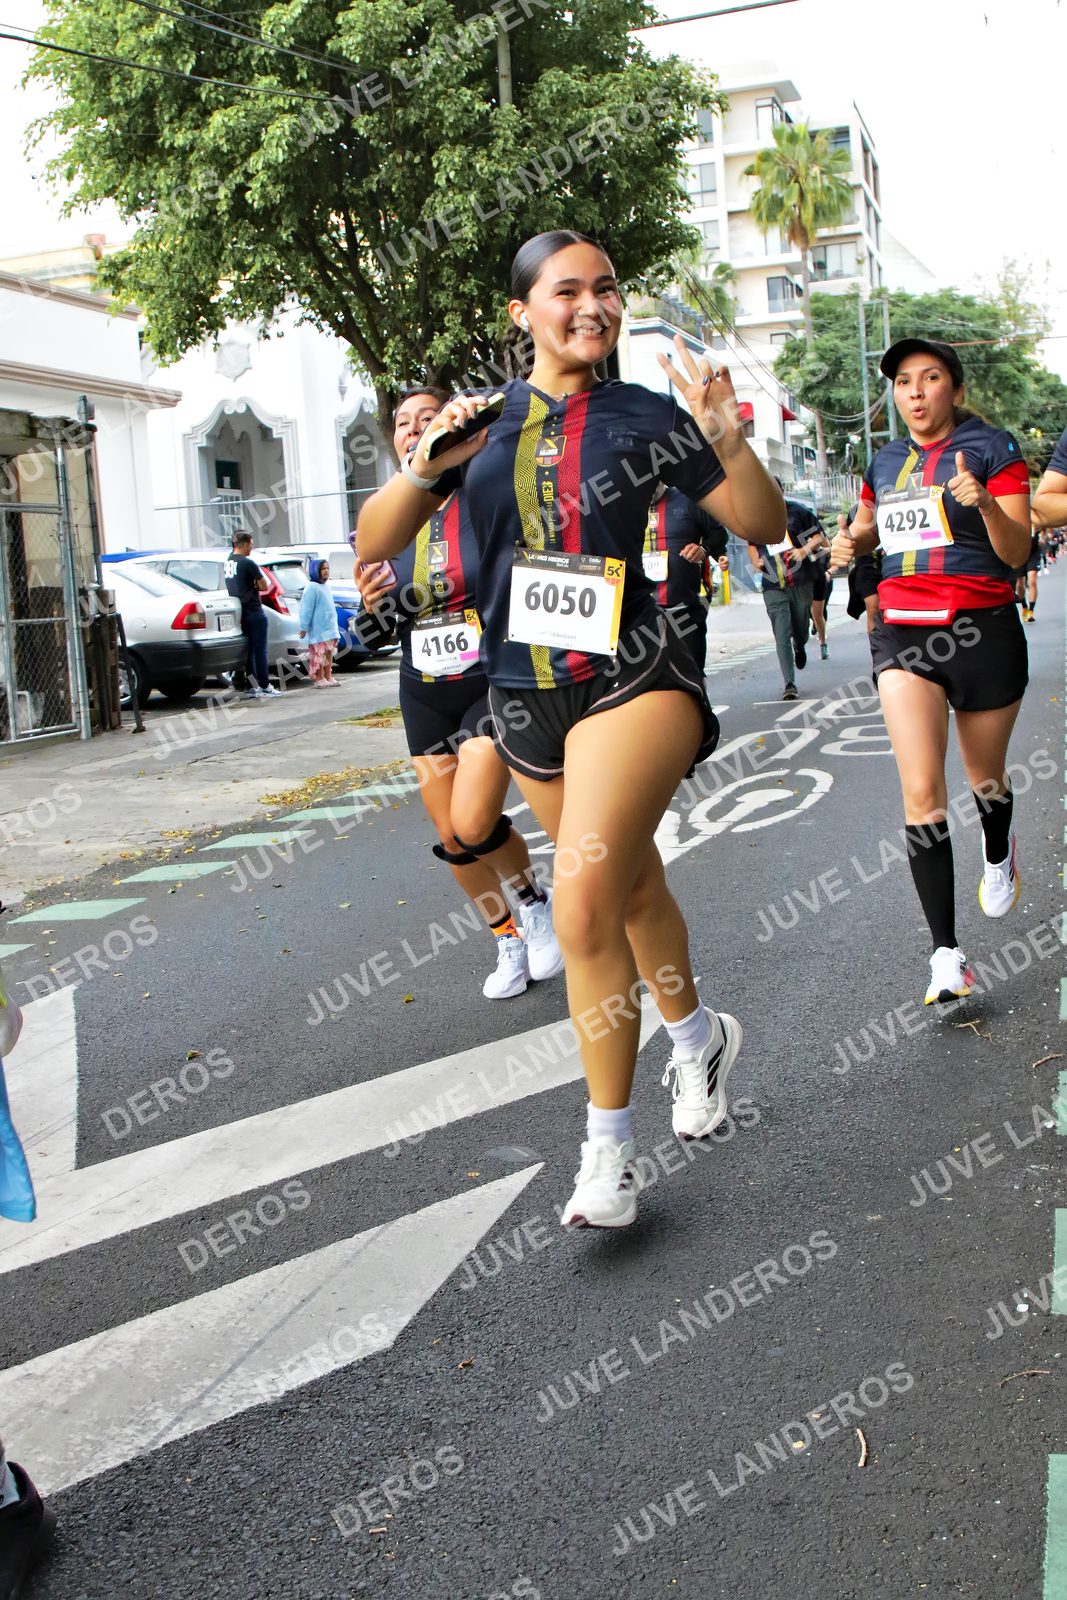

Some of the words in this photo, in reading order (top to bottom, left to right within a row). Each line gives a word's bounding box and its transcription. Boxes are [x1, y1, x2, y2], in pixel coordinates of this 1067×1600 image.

[885, 507, 931, 533] 4292
[525, 581, 597, 618] 6050
[422, 631, 469, 657] 4166
